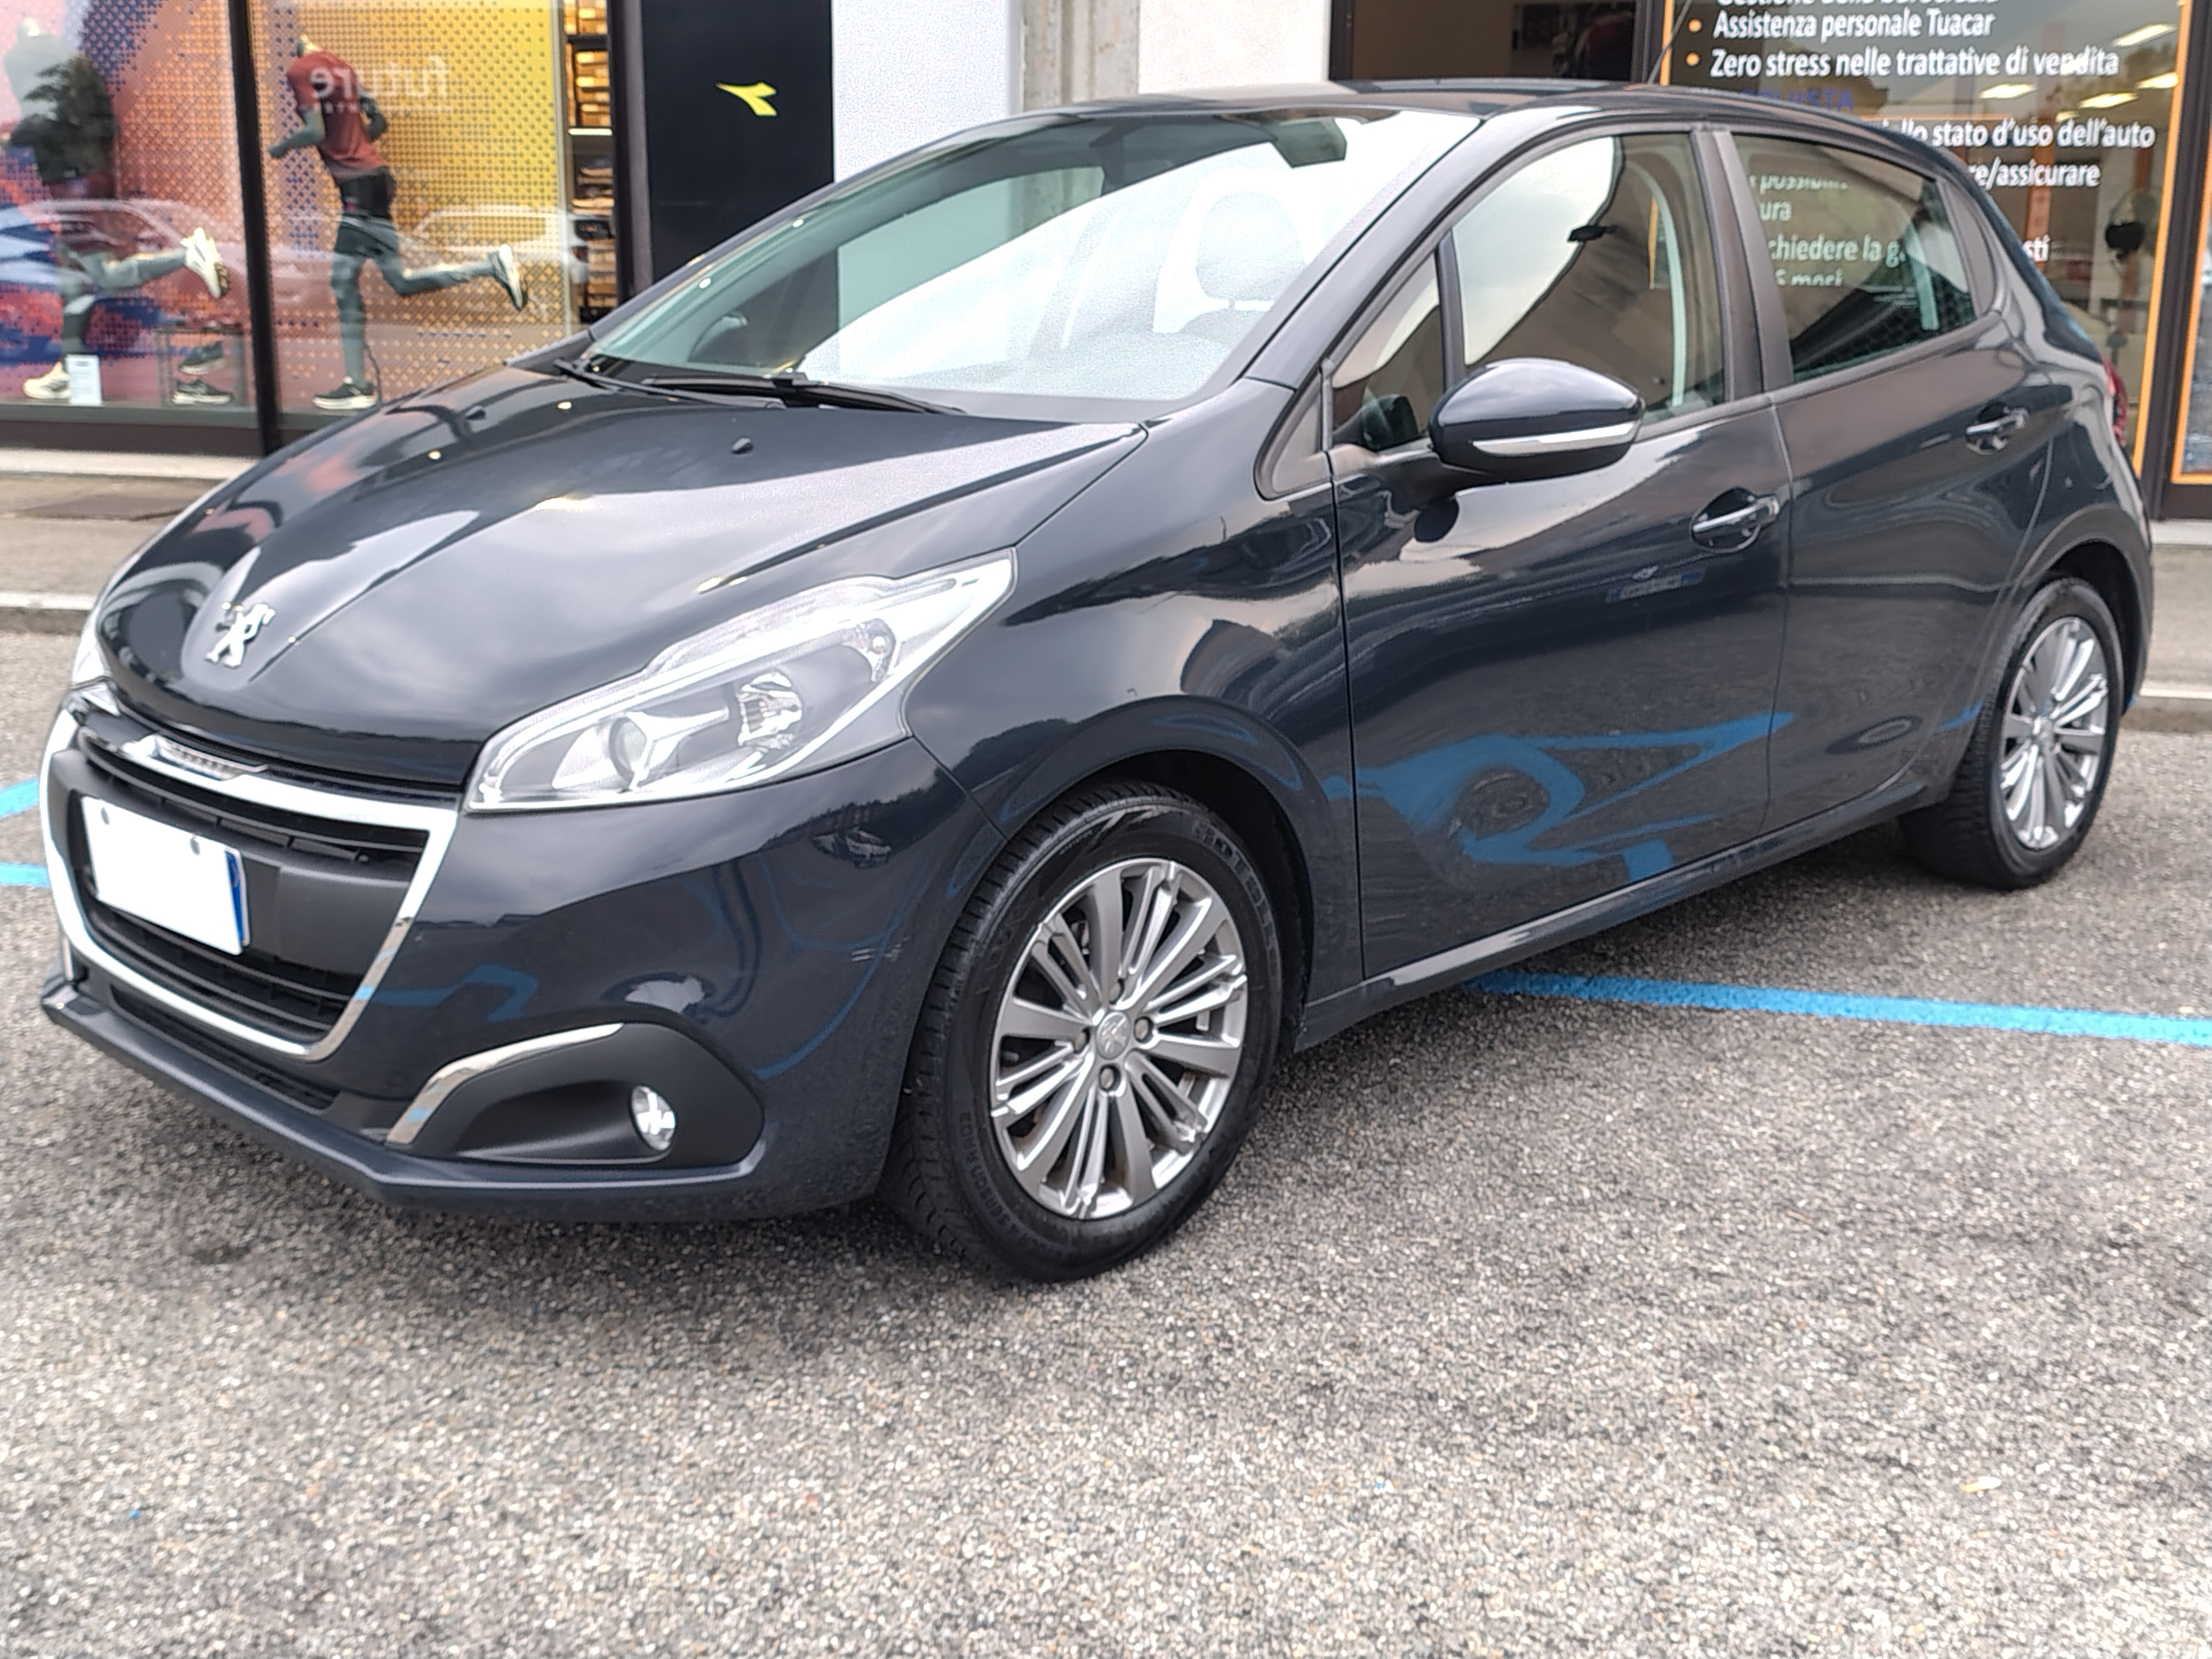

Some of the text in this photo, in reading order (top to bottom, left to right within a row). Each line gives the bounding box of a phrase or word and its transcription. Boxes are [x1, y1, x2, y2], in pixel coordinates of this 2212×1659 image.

[1713, 6, 1997, 45] Assistenza personale Tuacar
[1710, 44, 2120, 77] Zero stress nelle trattative di vendita
[1932, 122, 1988, 147] stato
[1863, 234, 1882, 261] la
